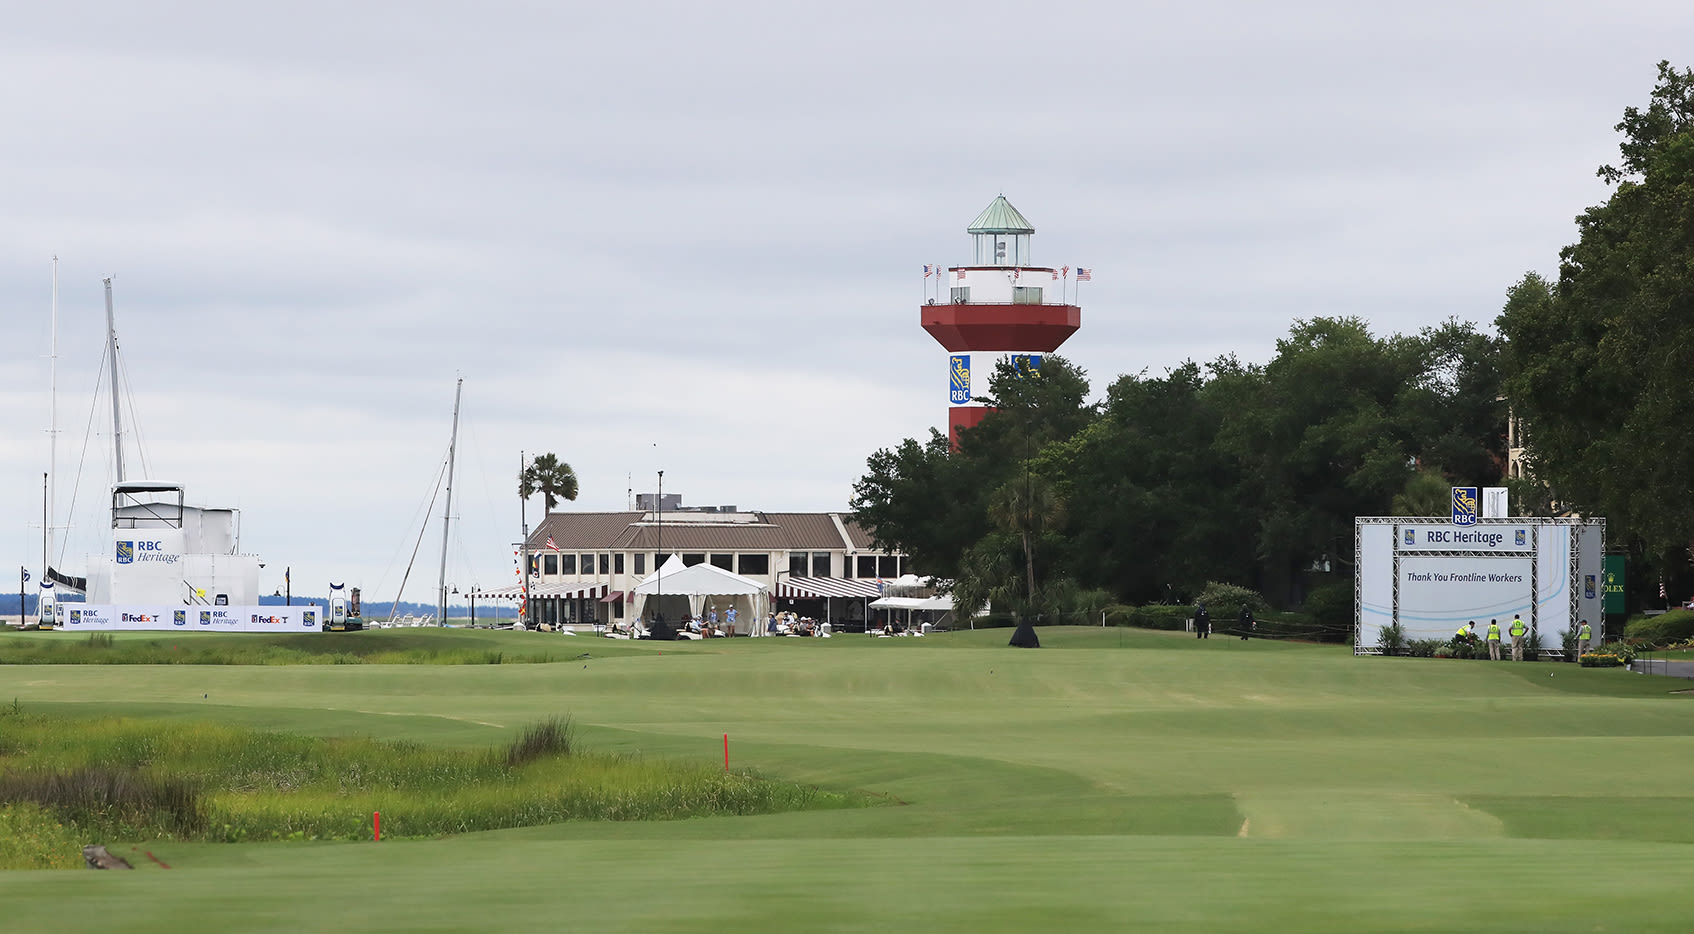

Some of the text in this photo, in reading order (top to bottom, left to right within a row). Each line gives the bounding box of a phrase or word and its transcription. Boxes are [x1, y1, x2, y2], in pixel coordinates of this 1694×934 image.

[952, 390, 969, 401] RBC
[1454, 514, 1475, 524] RBC
[1427, 530, 1503, 547] RBC Heritage
[138, 541, 162, 551] RBC
[137, 552, 180, 564] Heritage
[1407, 572, 1522, 583] Thank You Frontline Workers
[1602, 585, 1624, 593] OLEX
[129, 614, 151, 622] FedEx
[258, 615, 280, 623] FedEx
